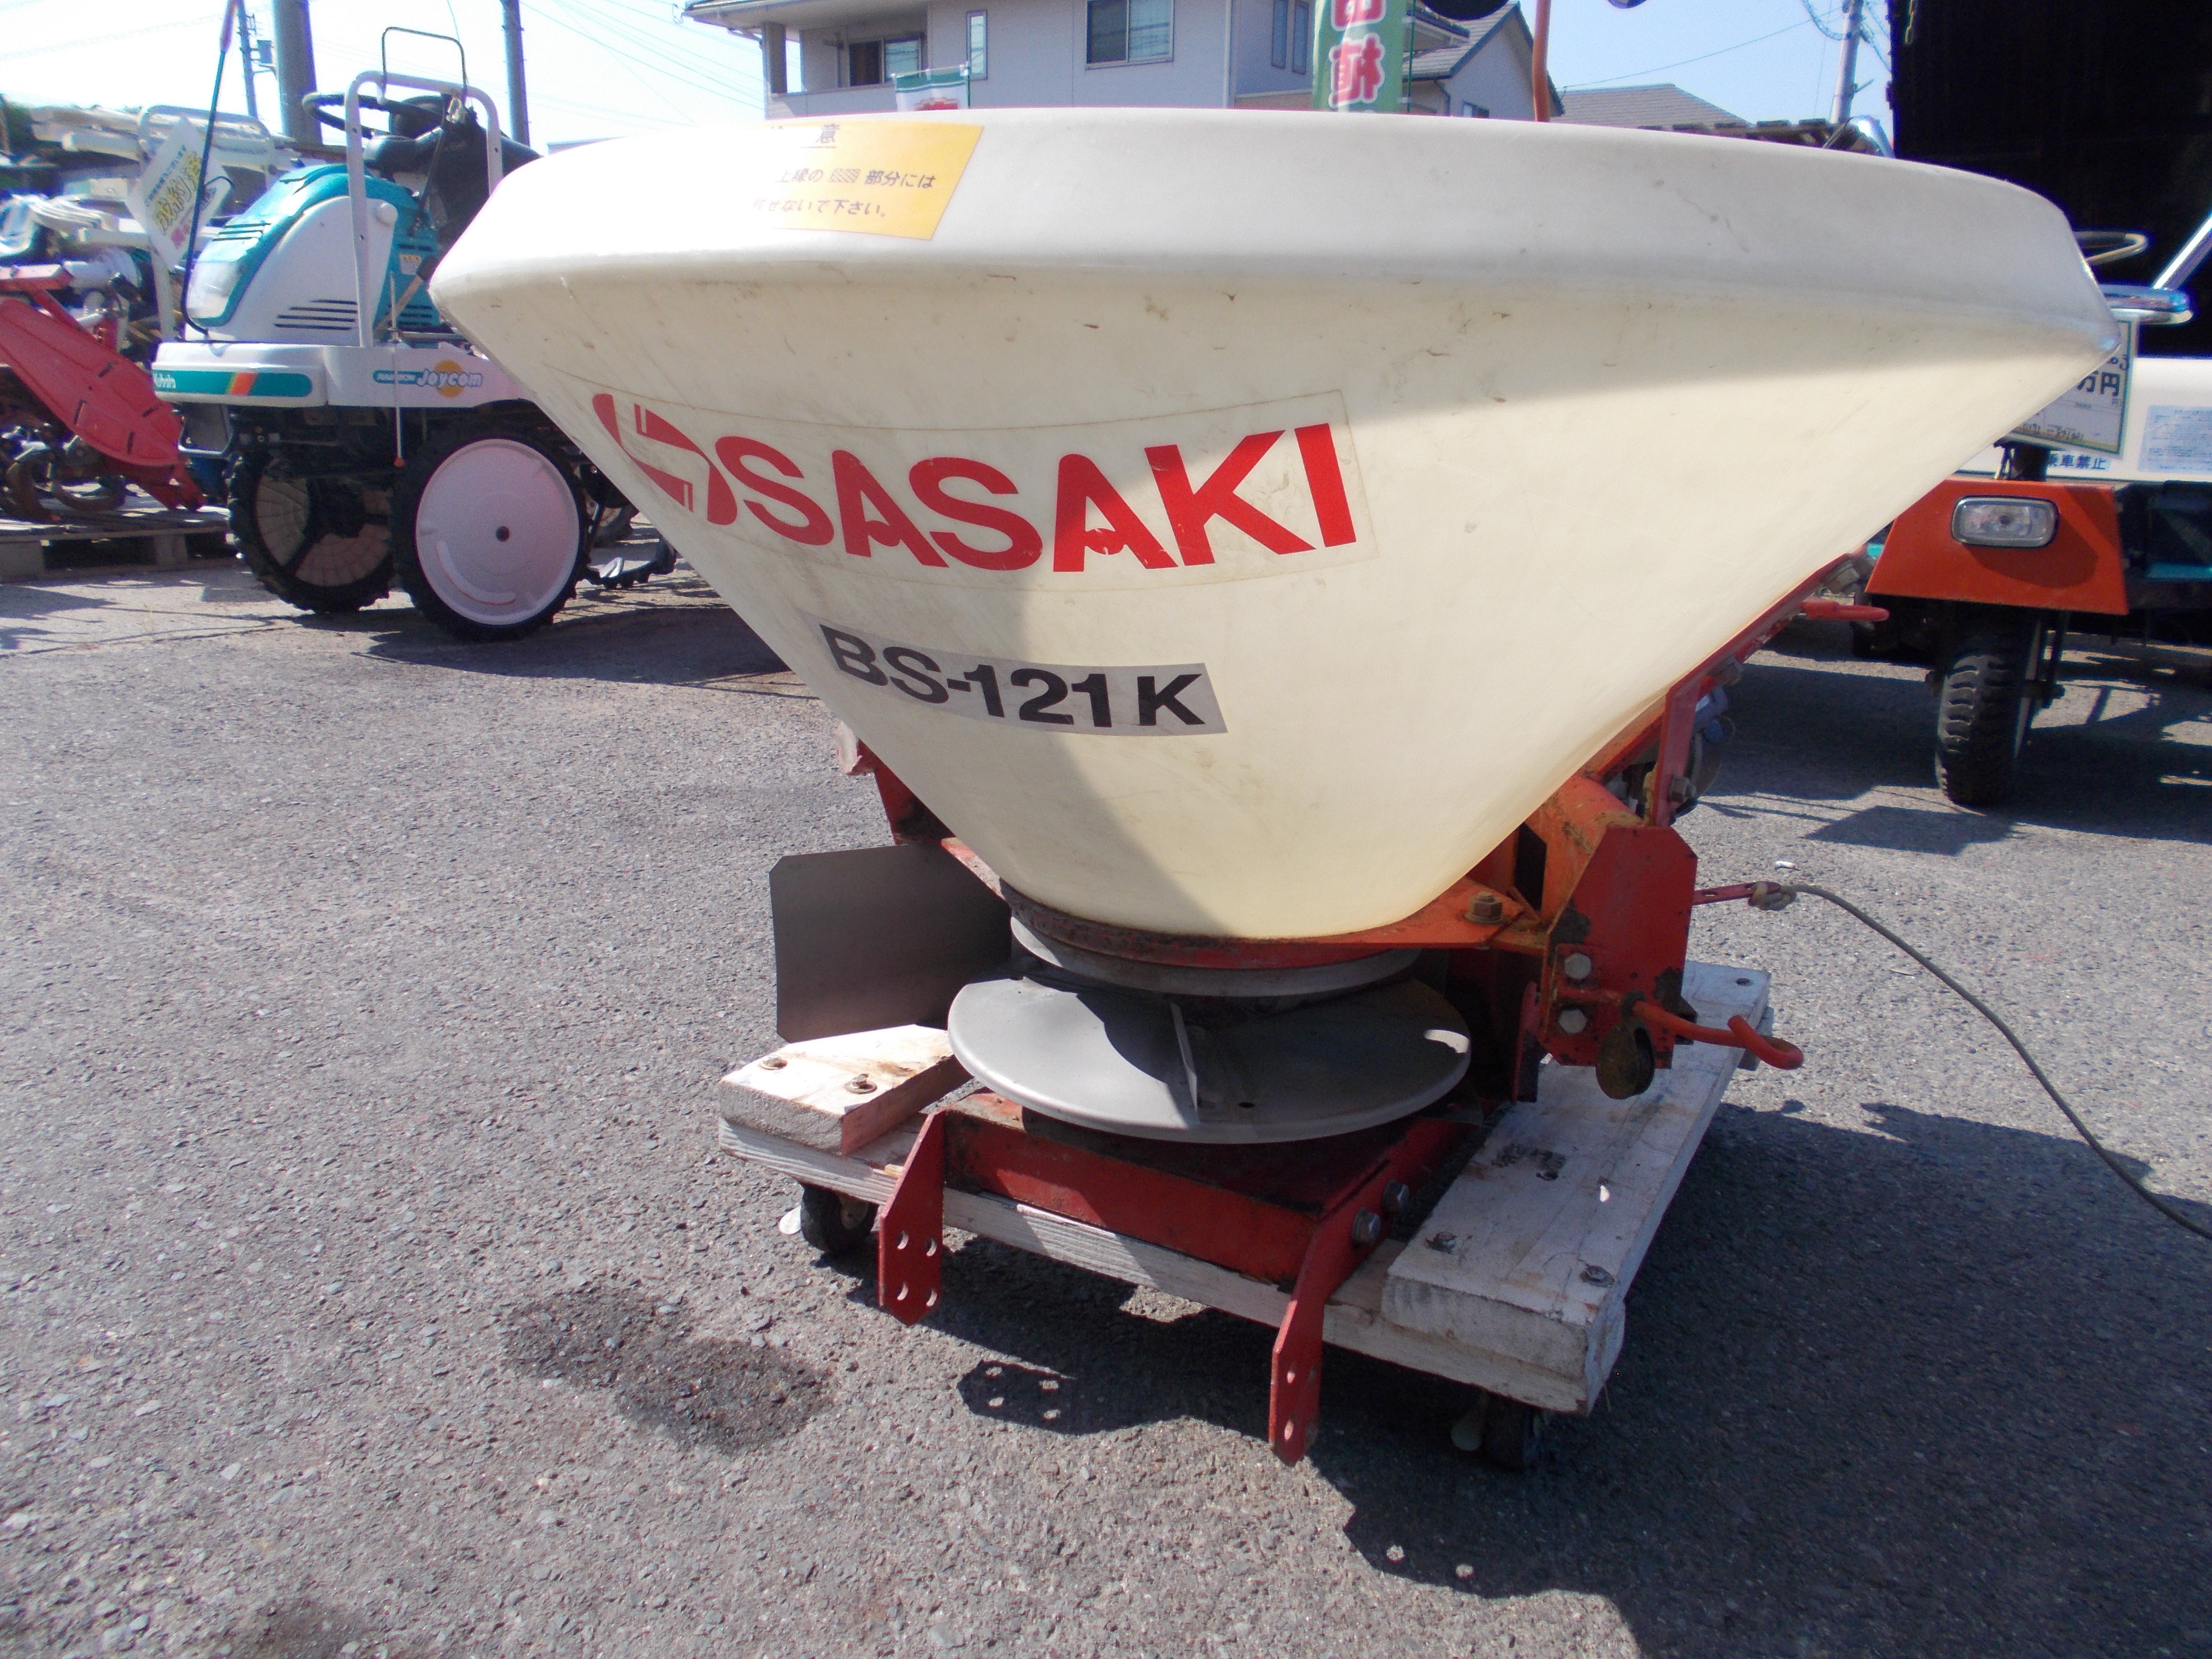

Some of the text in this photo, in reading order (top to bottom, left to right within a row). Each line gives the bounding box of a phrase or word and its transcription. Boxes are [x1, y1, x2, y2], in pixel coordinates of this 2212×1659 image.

[865, 169, 936, 189] 部分には
[417, 368, 483, 389] Joycom
[715, 423, 1357, 572] SASAKI
